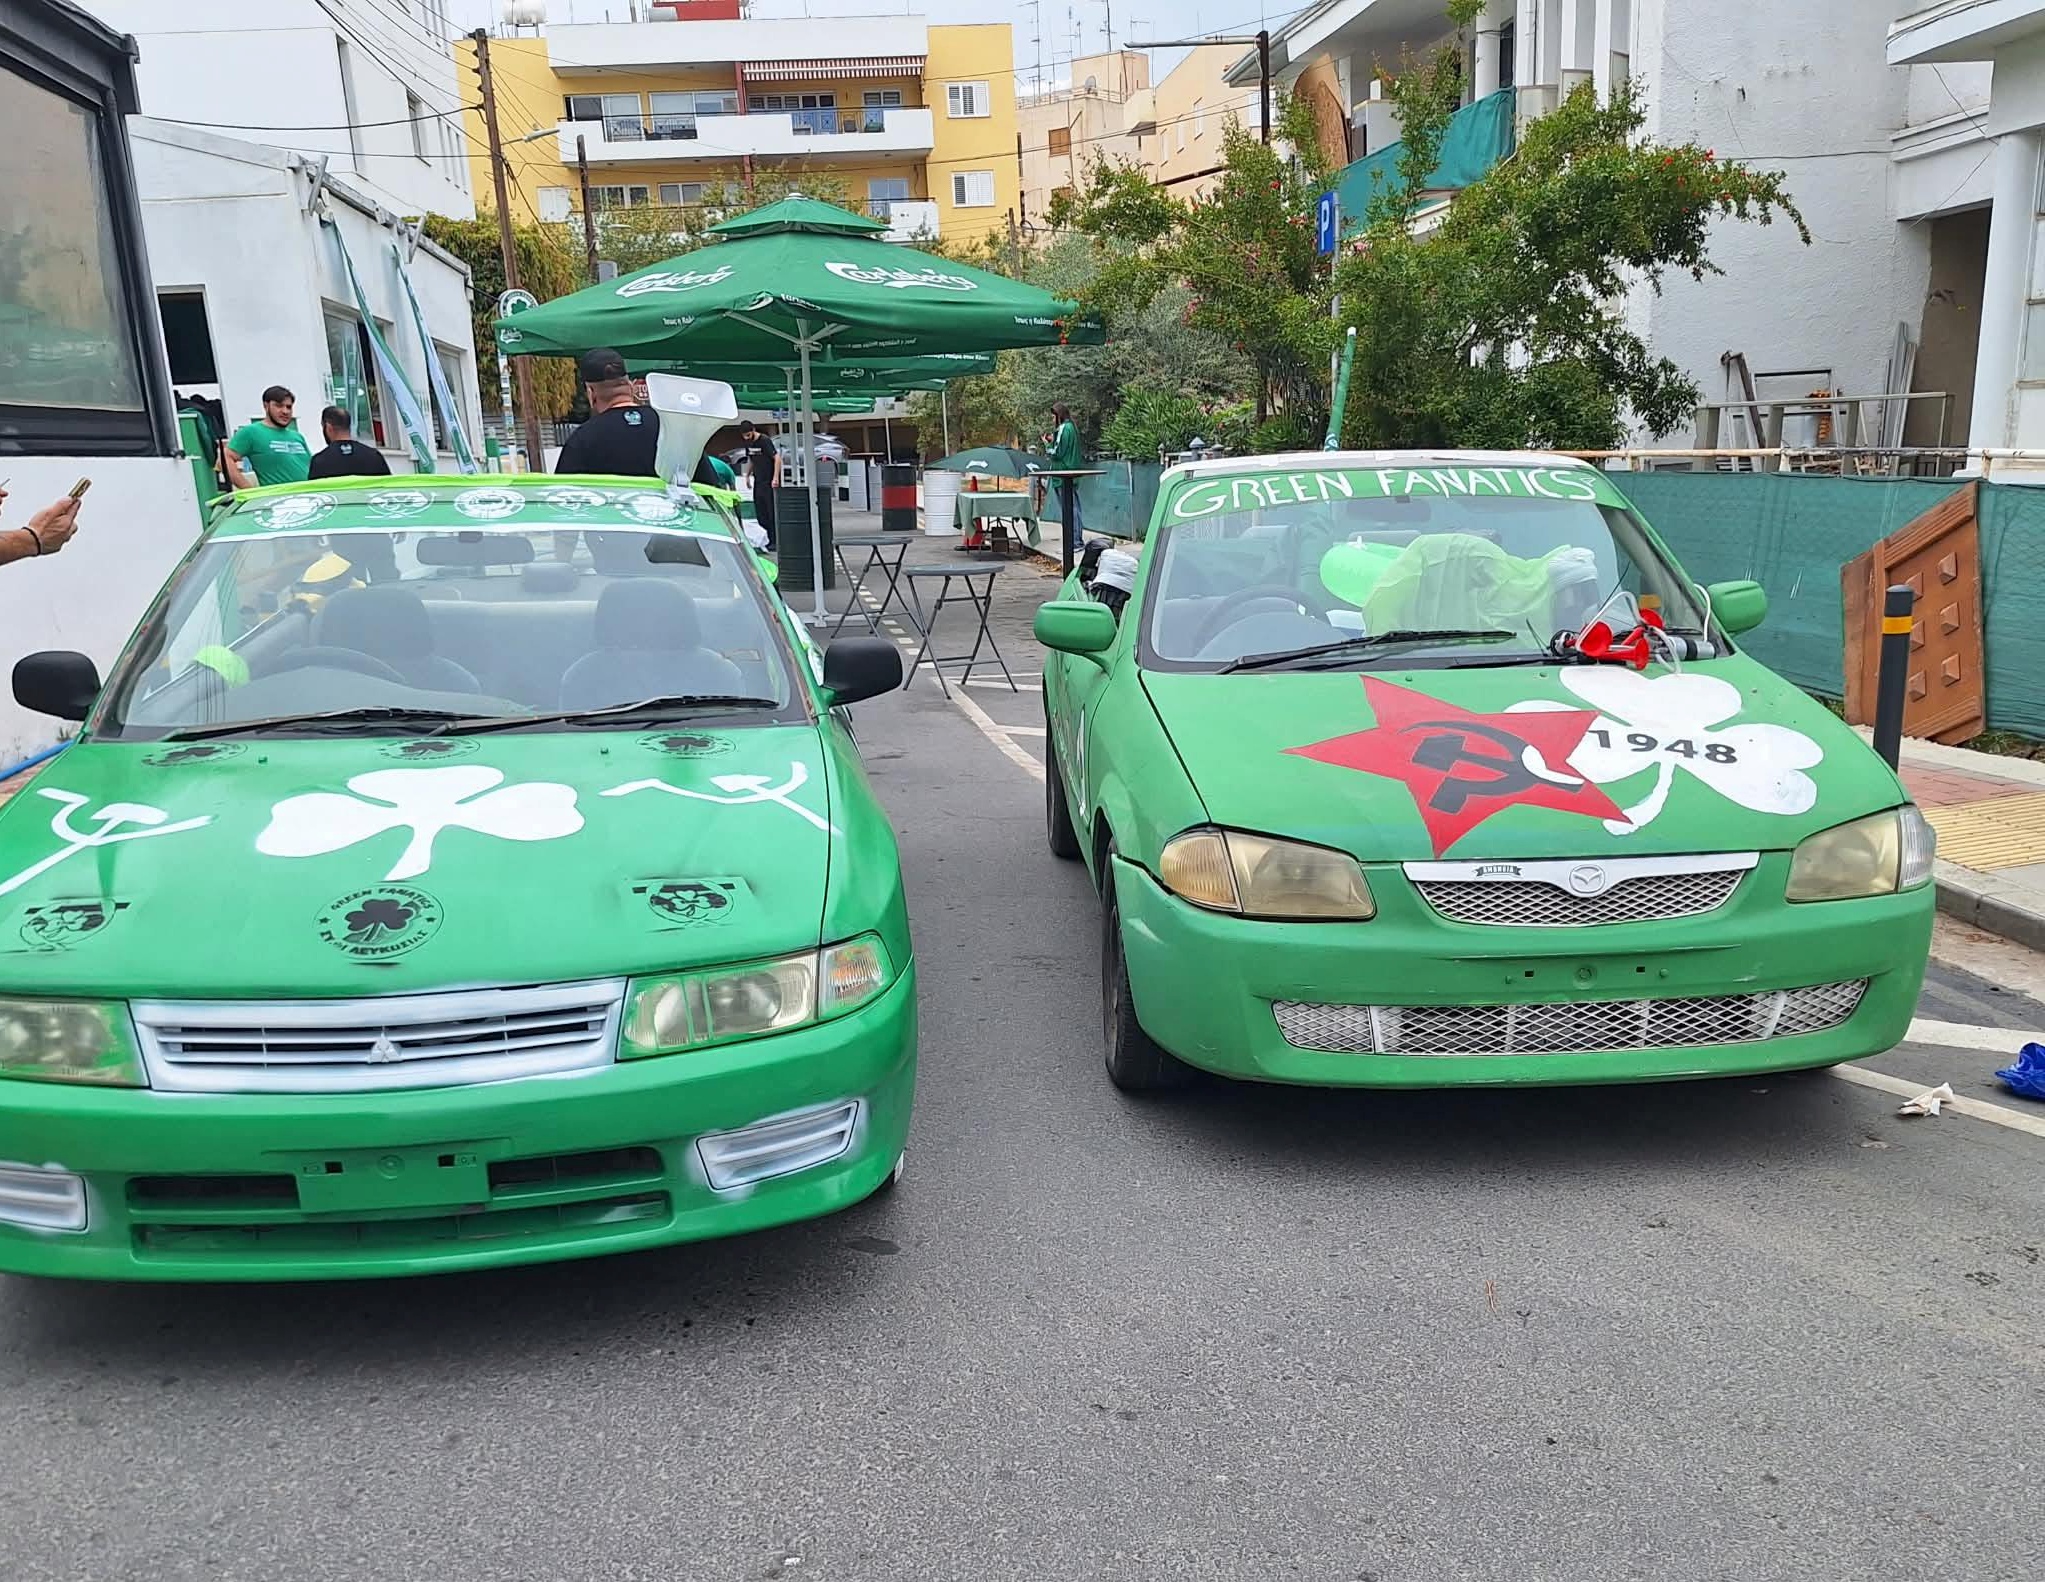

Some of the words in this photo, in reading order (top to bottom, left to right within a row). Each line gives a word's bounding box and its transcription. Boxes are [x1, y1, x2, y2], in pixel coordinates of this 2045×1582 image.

[1321, 199, 1330, 251] P
[824, 261, 979, 291] Carlsberg
[1173, 471, 1355, 518] GREEN
[1375, 467, 1598, 500] FANATICS
[1588, 729, 1738, 764] 1948
[331, 890, 372, 910] GREEN
[378, 888, 435, 909] FANATICS
